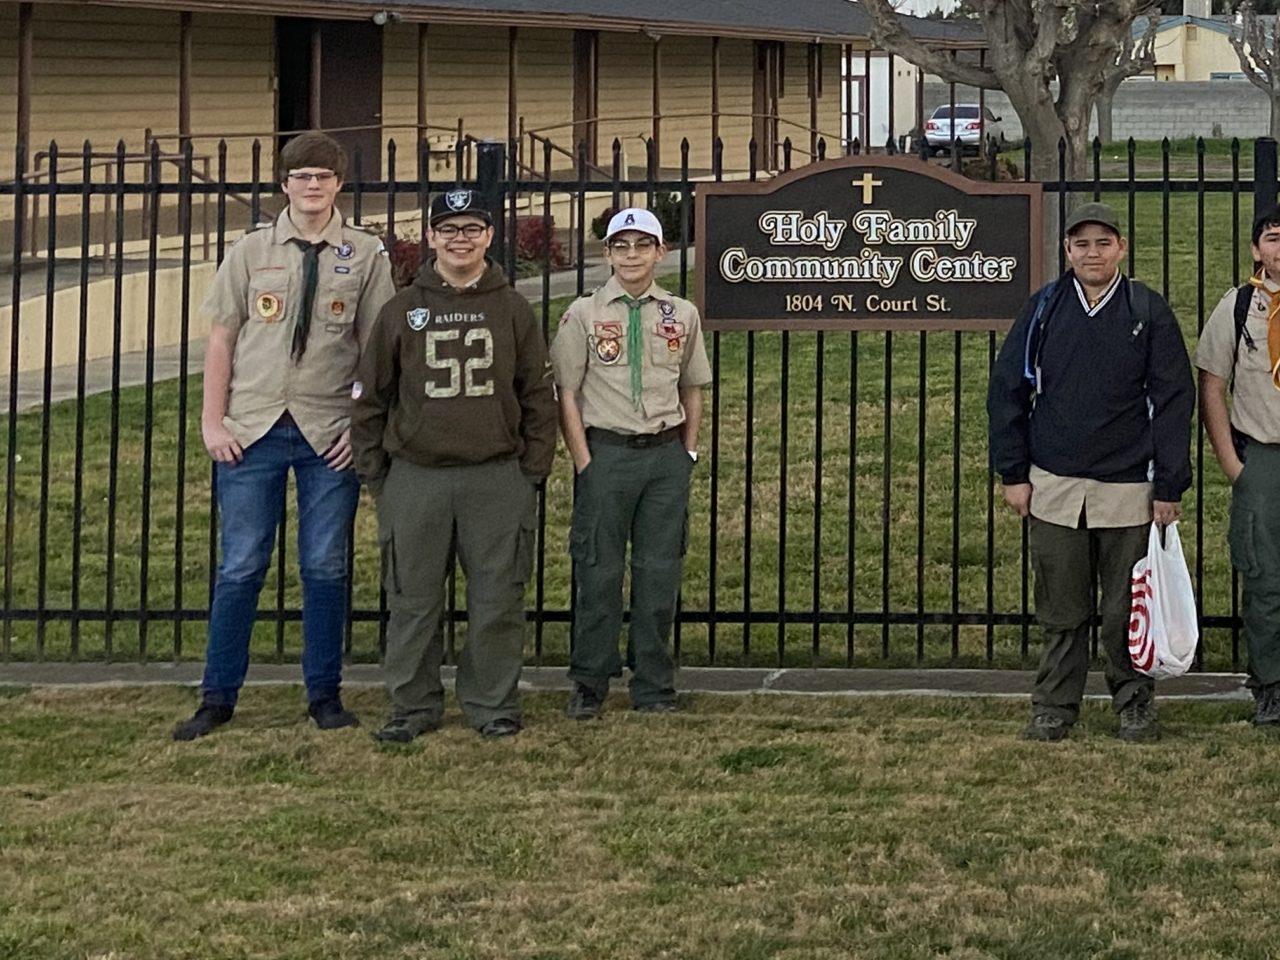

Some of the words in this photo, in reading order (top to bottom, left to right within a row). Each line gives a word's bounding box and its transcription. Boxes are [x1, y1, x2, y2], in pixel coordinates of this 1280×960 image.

[760, 211, 846, 250] Holy
[854, 210, 976, 248] Family
[720, 248, 903, 288] Community
[910, 247, 1016, 283] Center
[435, 312, 485, 324] RAIDERS
[785, 295, 823, 312] 1804
[831, 295, 857, 312] N.
[866, 295, 918, 312] Court
[926, 295, 951, 312] St.
[425, 328, 494, 398] 52
